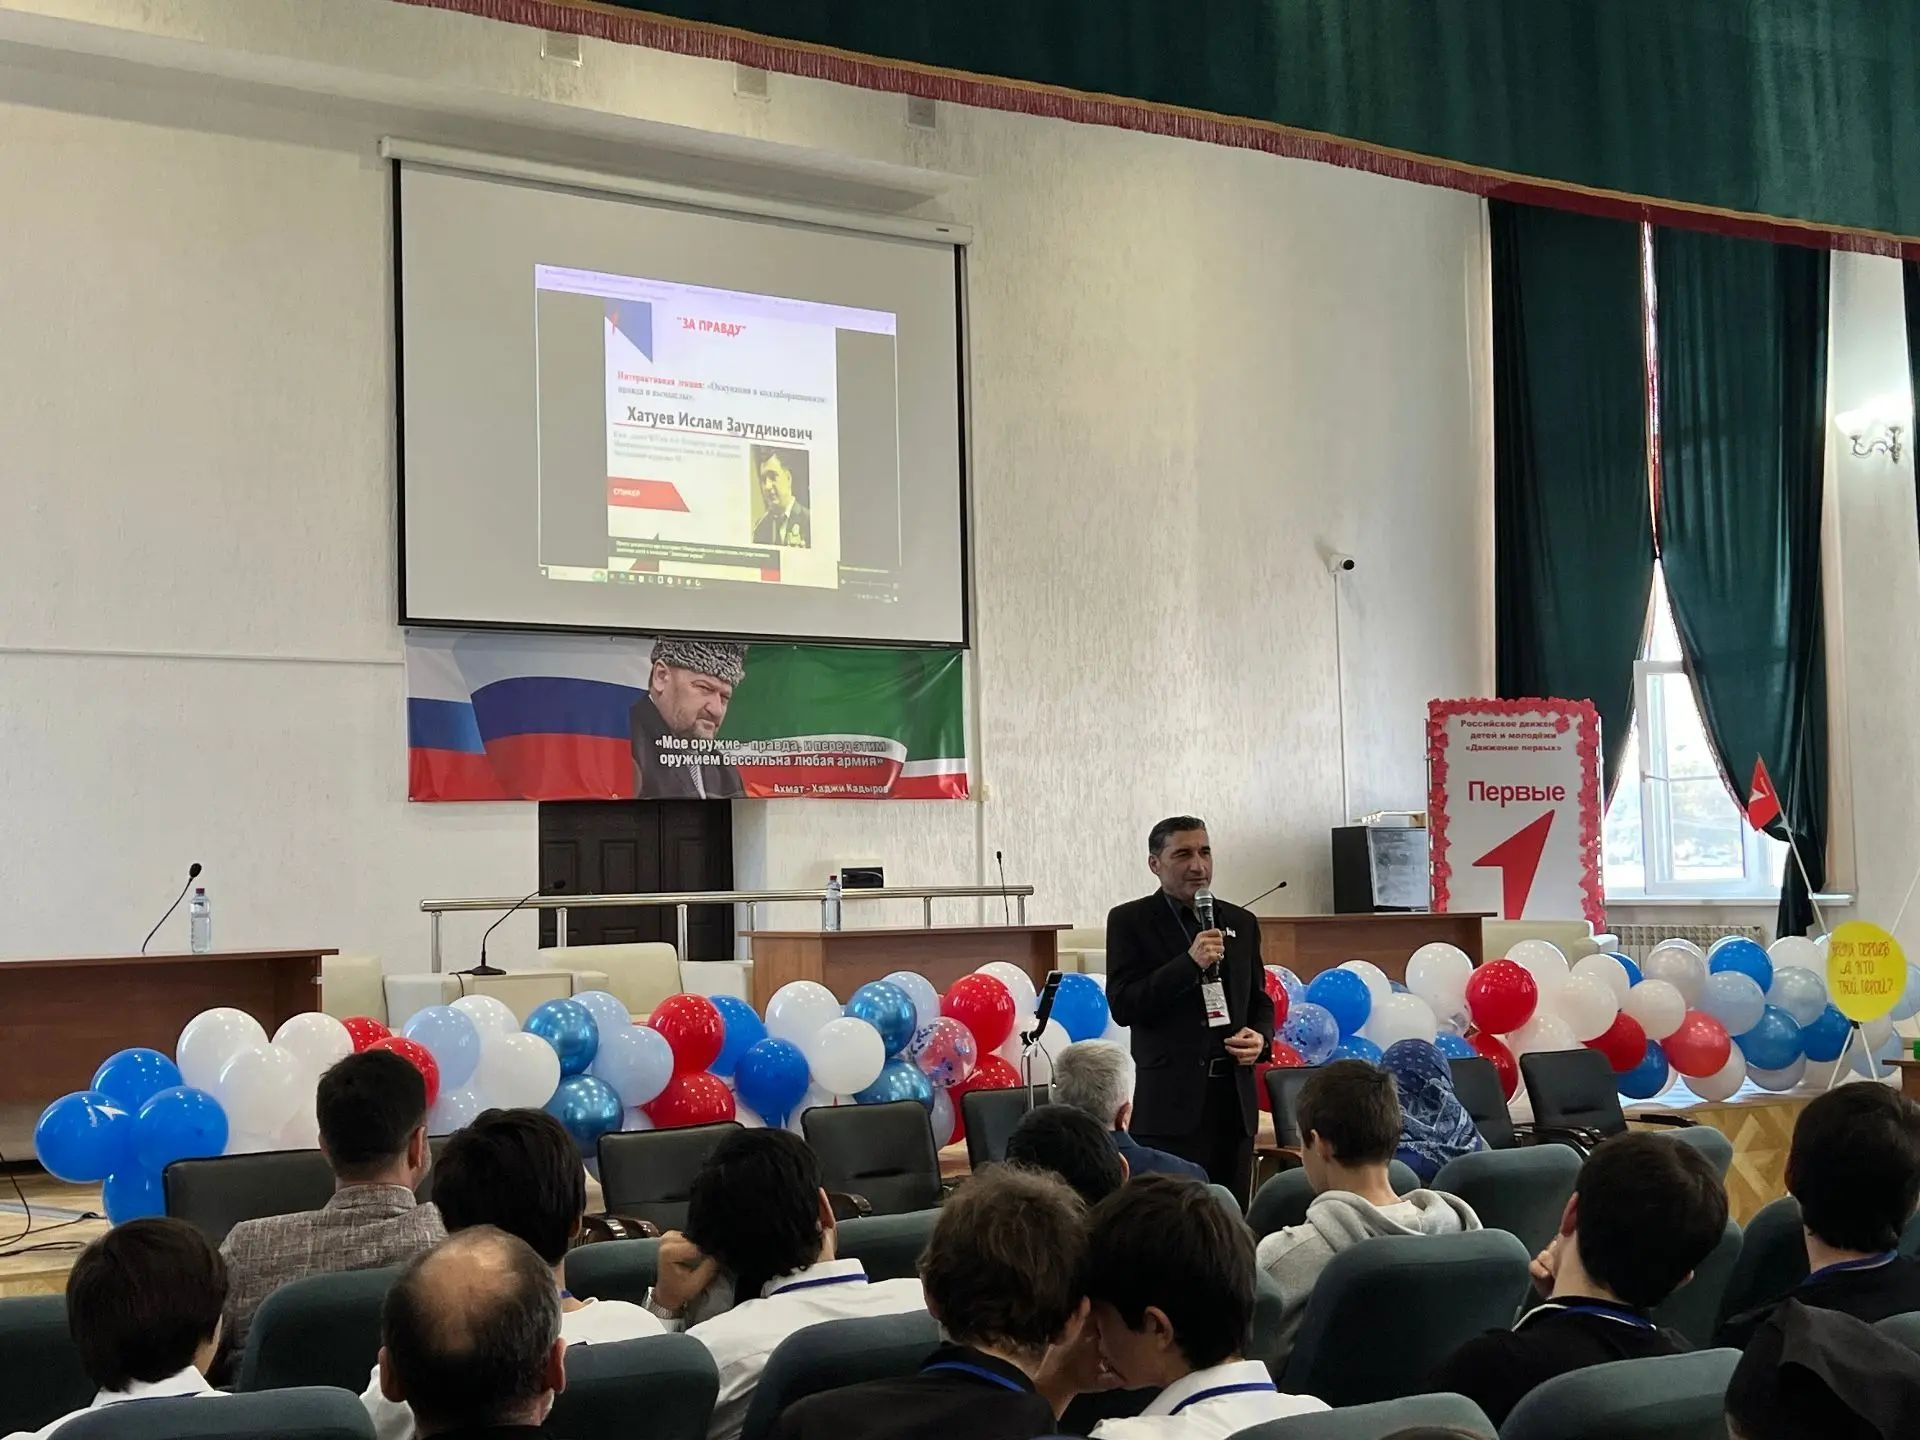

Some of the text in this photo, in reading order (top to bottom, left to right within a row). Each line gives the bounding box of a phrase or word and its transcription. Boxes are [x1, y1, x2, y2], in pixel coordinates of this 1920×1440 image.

[698, 319, 747, 338] ПРАВДУ"
[627, 405, 813, 440] Хатуев Ислам Заутдинович
[1460, 719, 1555, 728] Российское движен
[1470, 732, 1497, 740] детей
[655, 735, 689, 750] «Мое
[691, 738, 740, 753] оружие
[751, 740, 802, 753] правда,
[804, 740, 813, 752] и
[814, 740, 850, 754] перед
[853, 741, 887, 752] этим
[1465, 743, 1562, 753] «Движение первых»
[659, 752, 884, 768] оружием бессильна любая армия»
[773, 783, 805, 794] Ахмат
[812, 783, 845, 795] Хаджи
[847, 783, 889, 796] Кадыров
[1468, 780, 1566, 808] Первые
